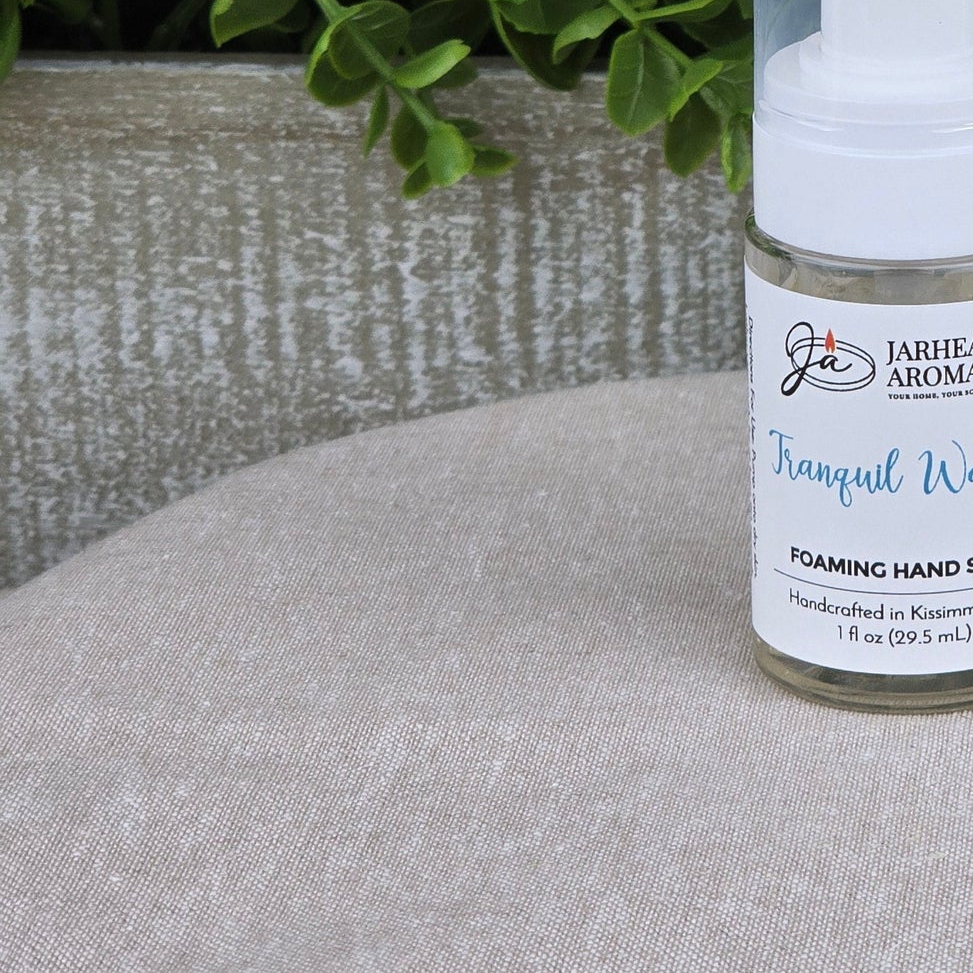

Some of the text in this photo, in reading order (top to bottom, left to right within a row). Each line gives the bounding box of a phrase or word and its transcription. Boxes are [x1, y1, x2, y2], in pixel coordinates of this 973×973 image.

[941, 390, 963, 398] YOUR
[769, 429, 904, 508] Tranquil
[790, 546, 887, 579] FOAMING
[893, 559, 961, 579] HAND
[789, 587, 884, 621] Handcrafted
[889, 604, 905, 621] in
[837, 623, 972, 648] 1 fl oz (29.5 mL)
